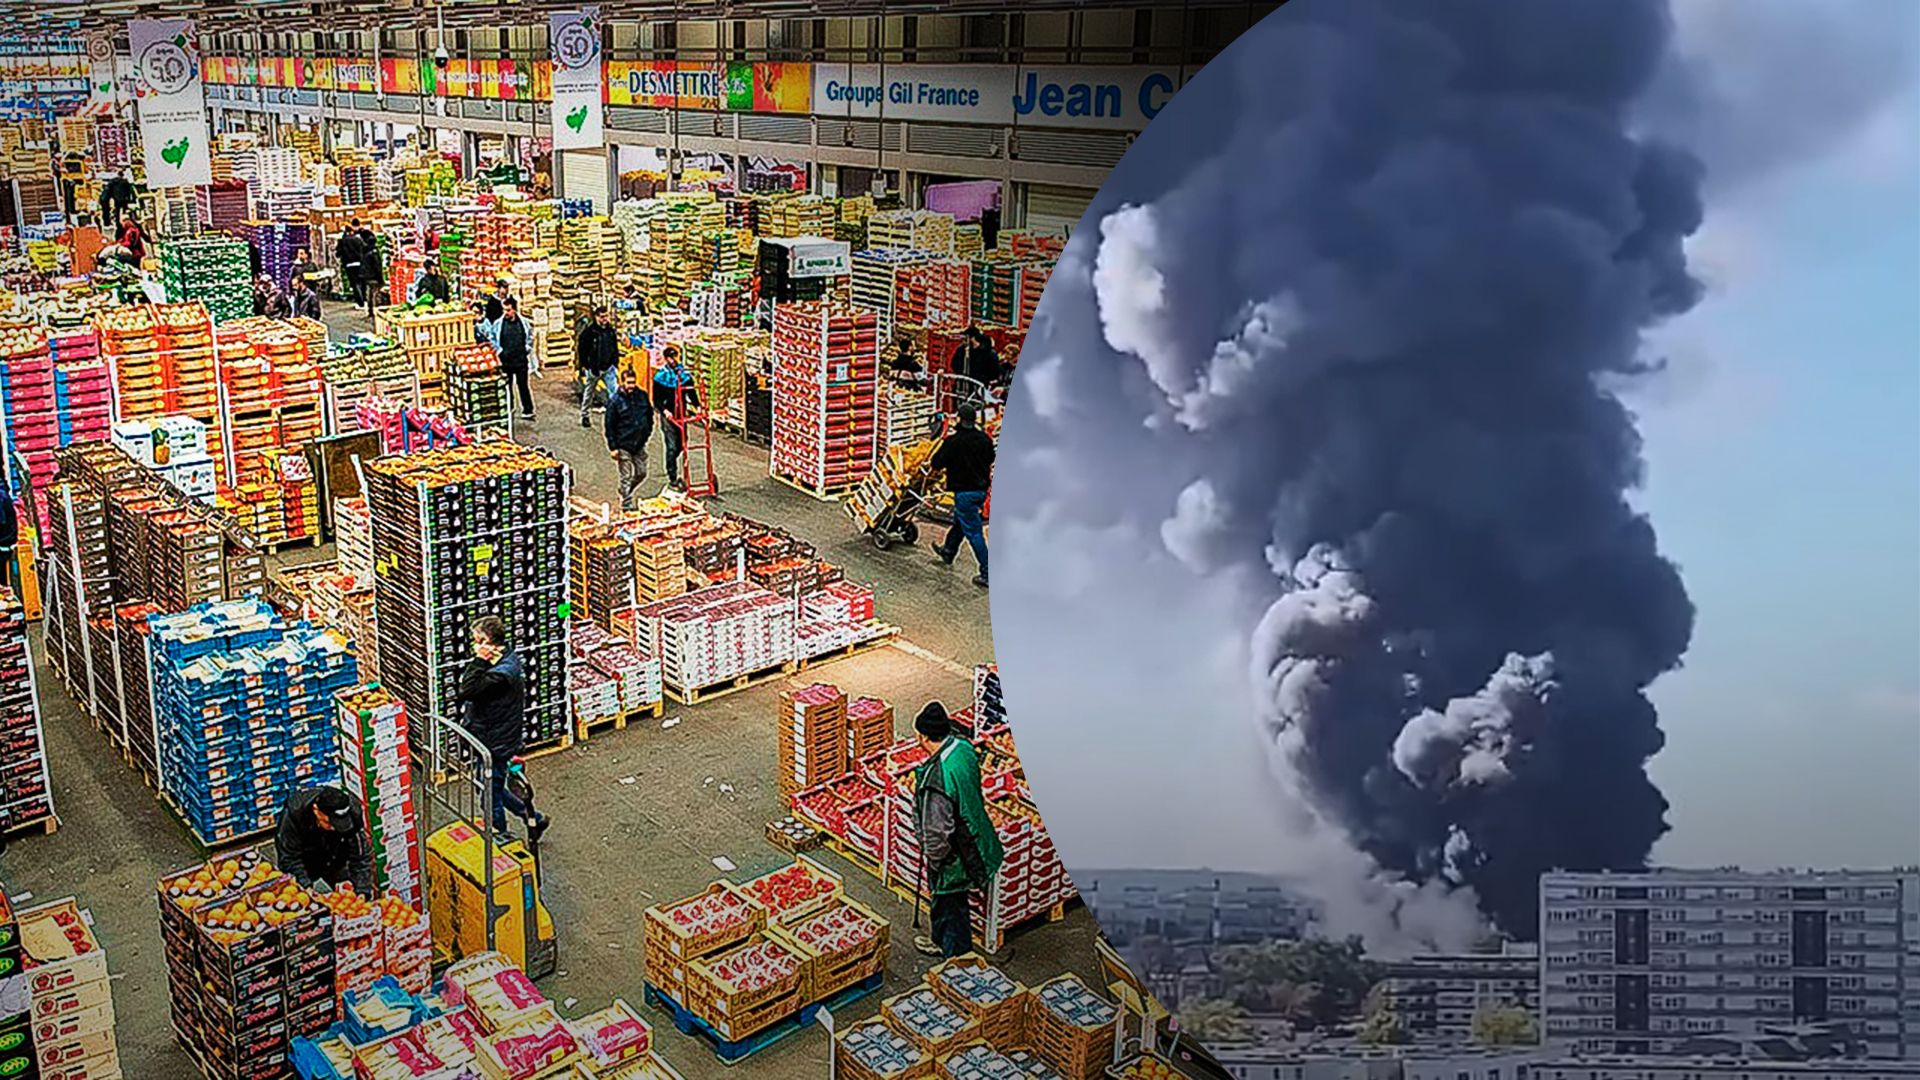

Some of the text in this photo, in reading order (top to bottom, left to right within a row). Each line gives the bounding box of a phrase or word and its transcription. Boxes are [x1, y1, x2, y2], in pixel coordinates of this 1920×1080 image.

[629, 71, 719, 97] DESMETTRE
[826, 80, 980, 108] Groupe Gil France
[1012, 72, 1198, 120] Jean C
